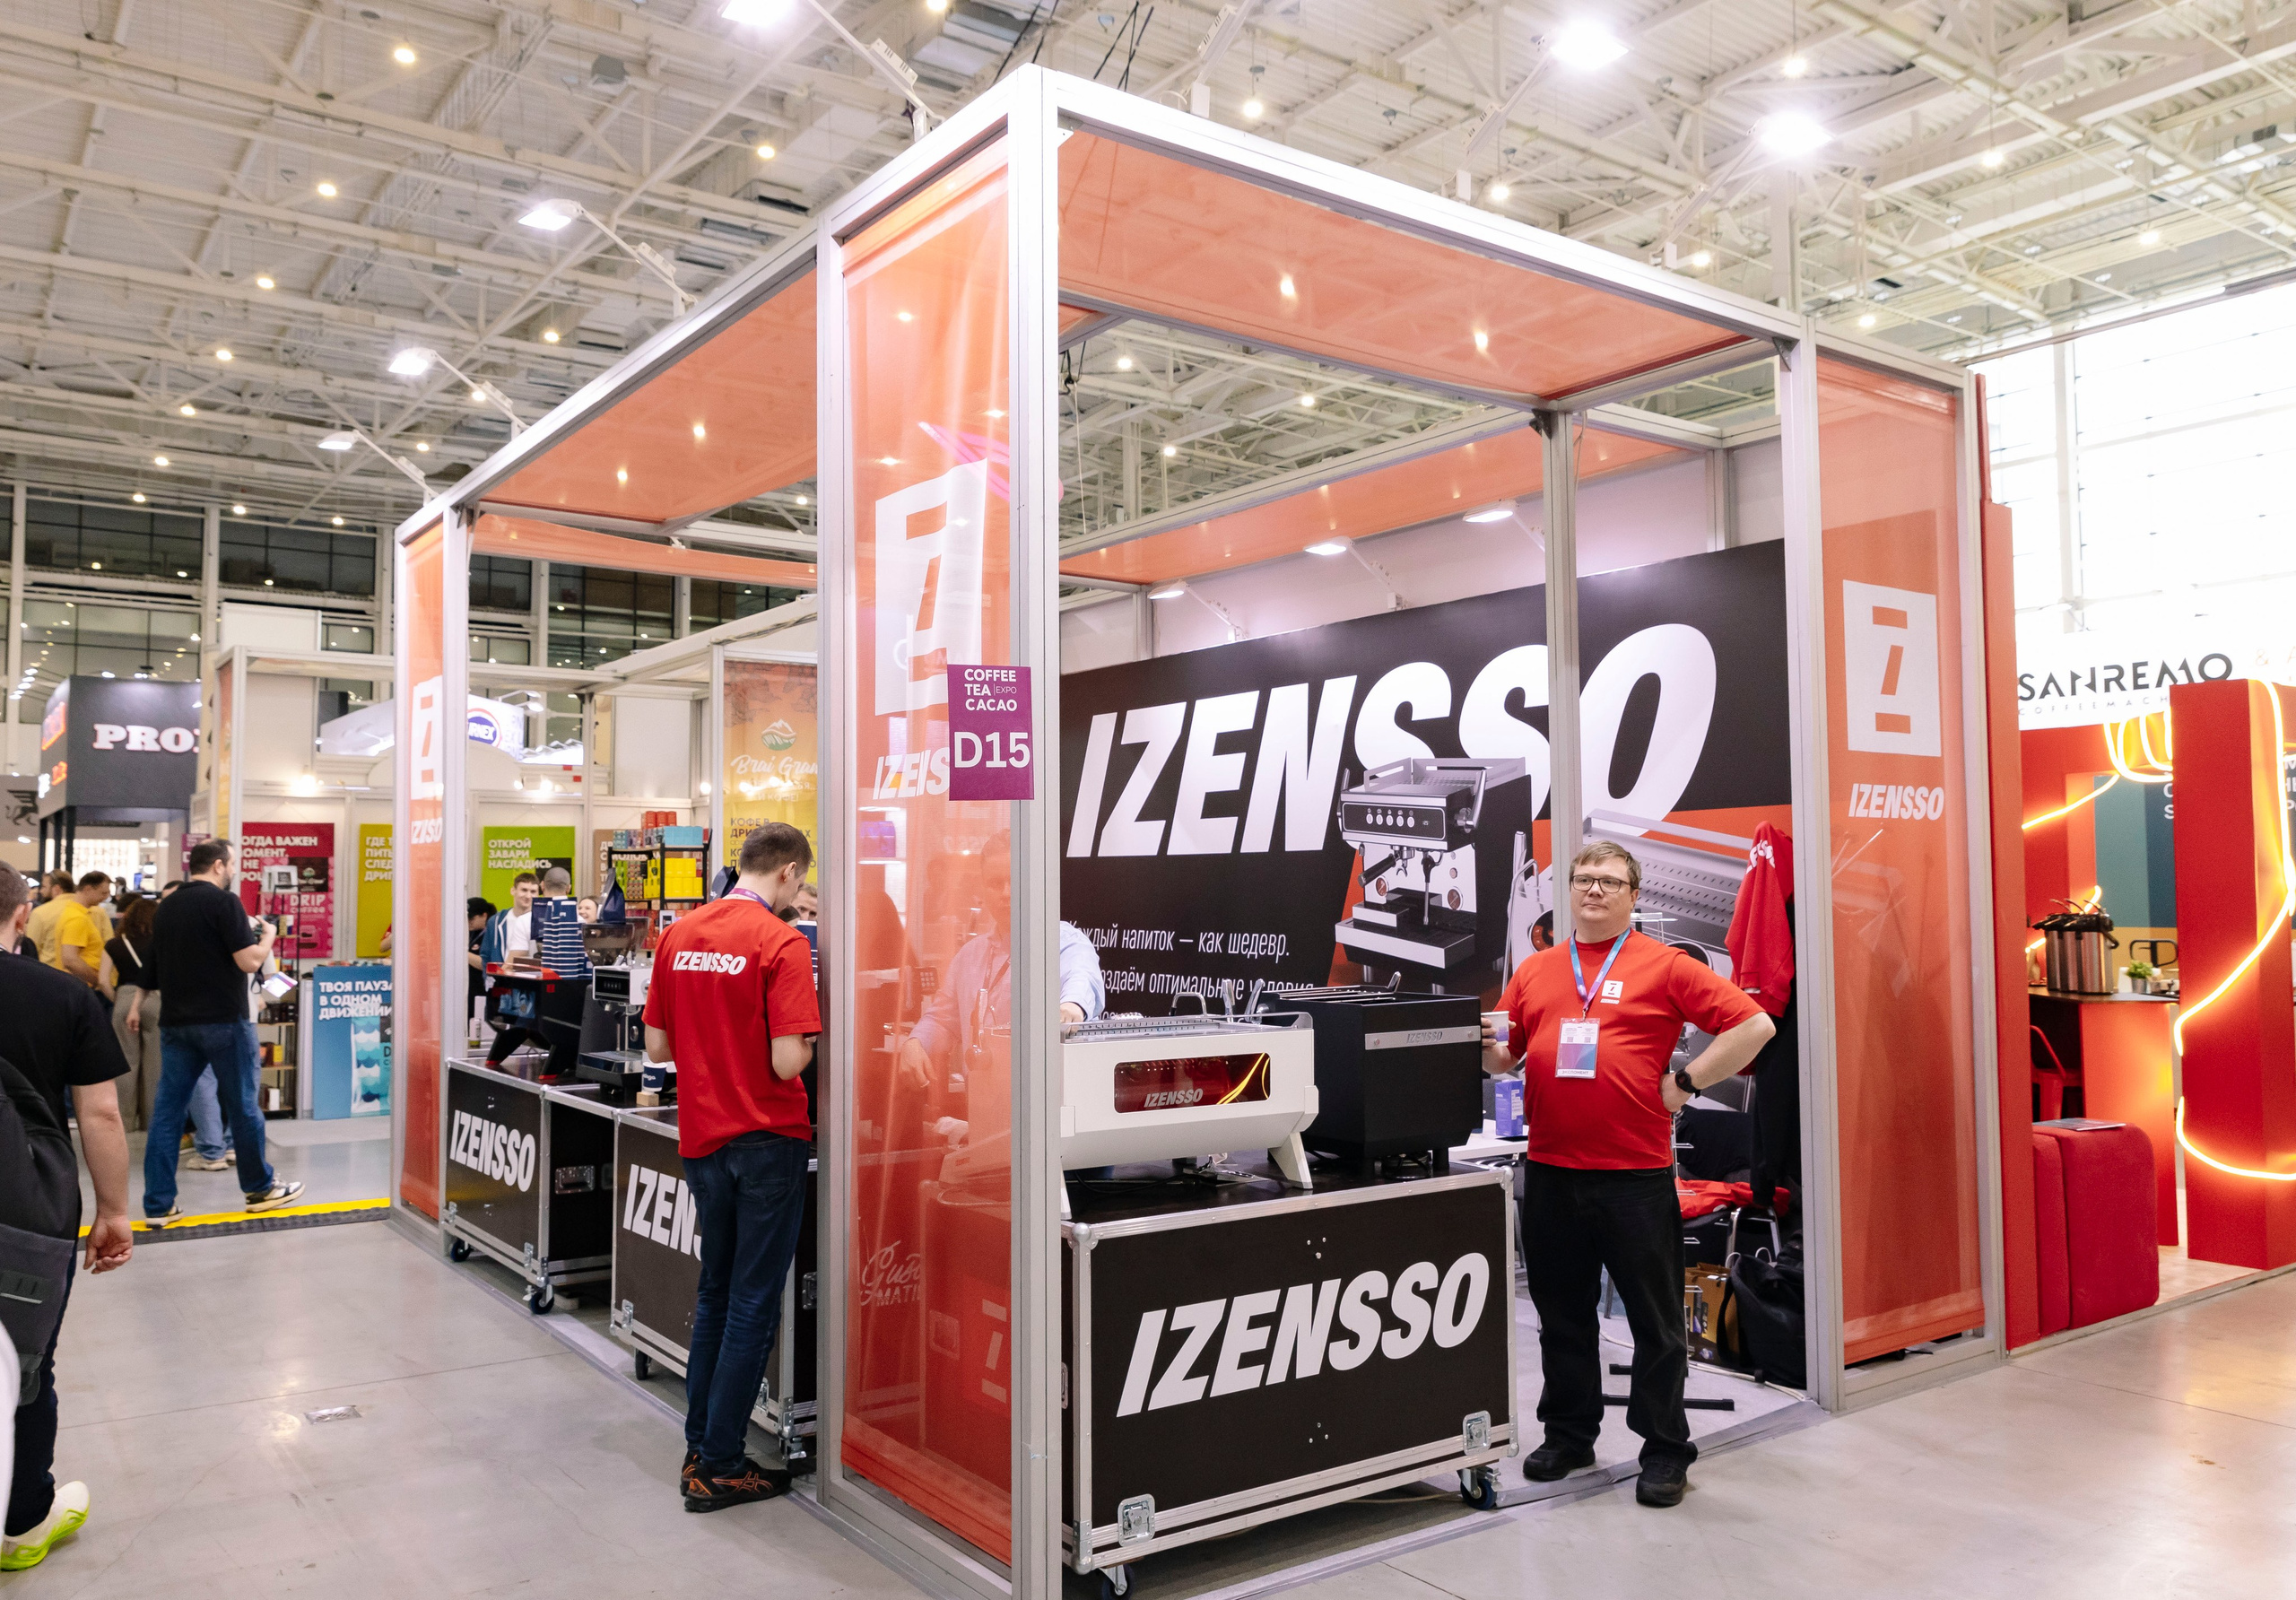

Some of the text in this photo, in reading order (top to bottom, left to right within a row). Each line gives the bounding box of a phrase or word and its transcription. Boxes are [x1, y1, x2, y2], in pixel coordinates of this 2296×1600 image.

[964, 668, 1016, 682] COFFEE
[2018, 653, 2232, 701] SANREMO
[964, 683, 1017, 696] TEA EXPO
[965, 699, 1017, 711] CACAO
[92, 724, 199, 753] PRO
[468, 722, 495, 741] RNEX
[1066, 623, 1717, 857] IZENSSO
[954, 731, 1031, 769] D15
[1848, 783, 1944, 821] IZENSSO
[241, 836, 318, 848] ОГДА ВАЖЕН
[488, 838, 532, 848] ОТКРОЙ
[242, 848, 290, 858] ОМЕНТ.
[488, 849, 530, 858] ЗАВАРИ
[488, 858, 552, 869] НАСЛАДИСЬ
[290, 894, 326, 907] DRIP
[1070, 920, 1118, 951] ждый
[1121, 927, 1175, 951] напиток
[1198, 931, 1222, 953] как
[1228, 932, 1290, 963] шедевр.
[673, 951, 746, 976] IZENSSO
[318, 981, 352, 993] ТВОЯ
[1150, 970, 1244, 1001] оптимальне
[319, 994, 383, 1007] В ОДНОМ
[1406, 1030, 1443, 1044] IZENSSO
[1144, 1088, 1204, 1108] IZENSSO
[449, 1109, 536, 1193] IZENSSO
[622, 1164, 701, 1262] IZEN
[1116, 1252, 1490, 1418] IZENSSO
